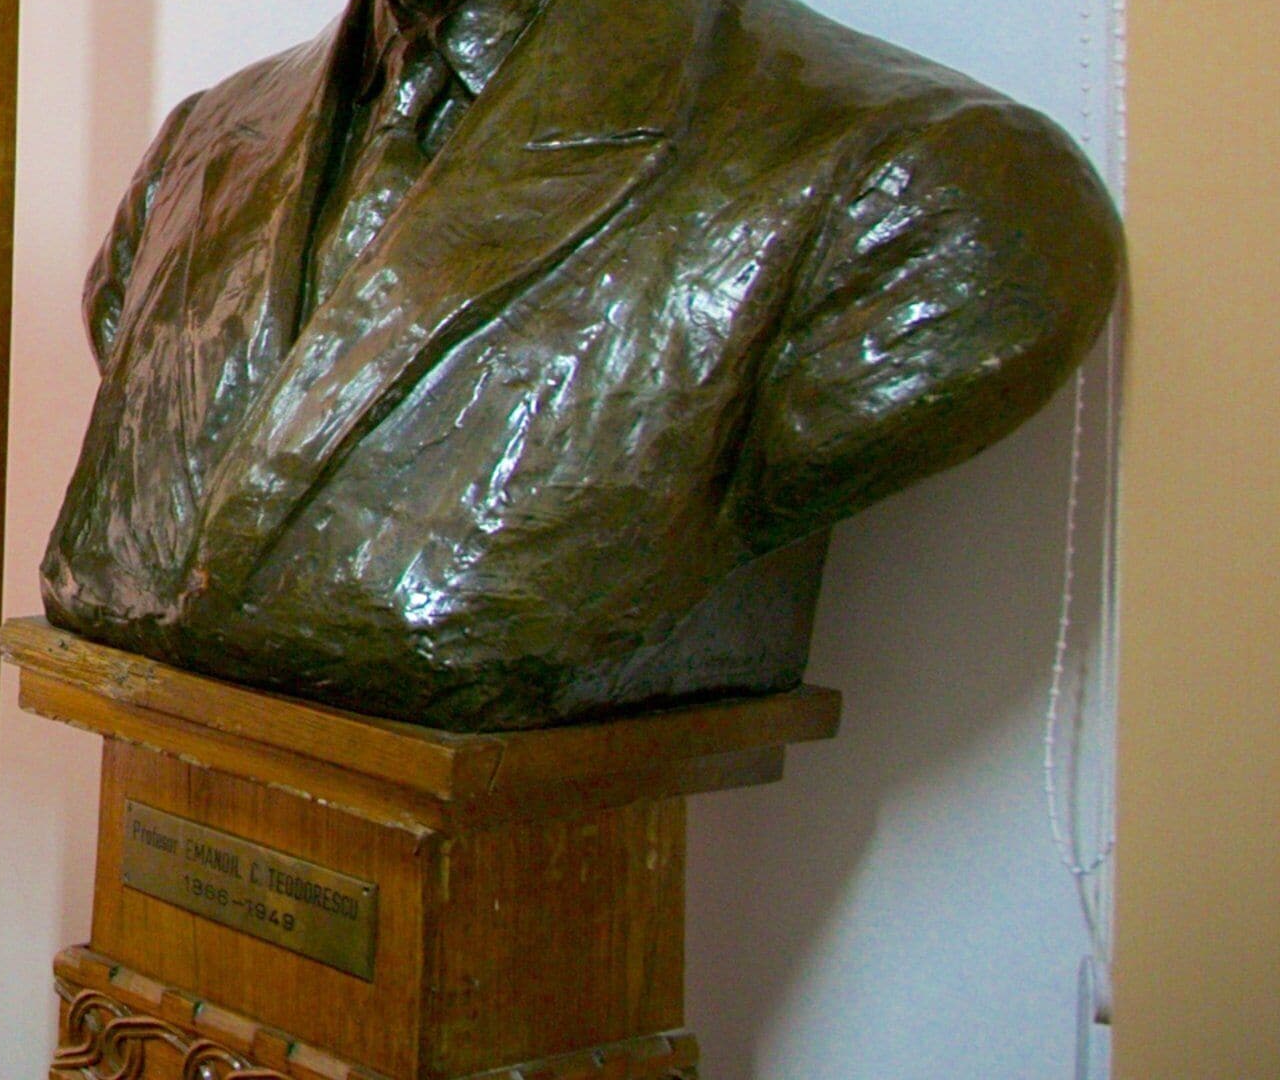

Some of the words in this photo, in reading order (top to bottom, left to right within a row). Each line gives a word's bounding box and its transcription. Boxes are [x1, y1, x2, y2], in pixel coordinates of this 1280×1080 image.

[132, 819, 177, 855] Profesor
[185, 838, 242, 880] EMANOIL
[268, 867, 359, 921] TEODORESCU
